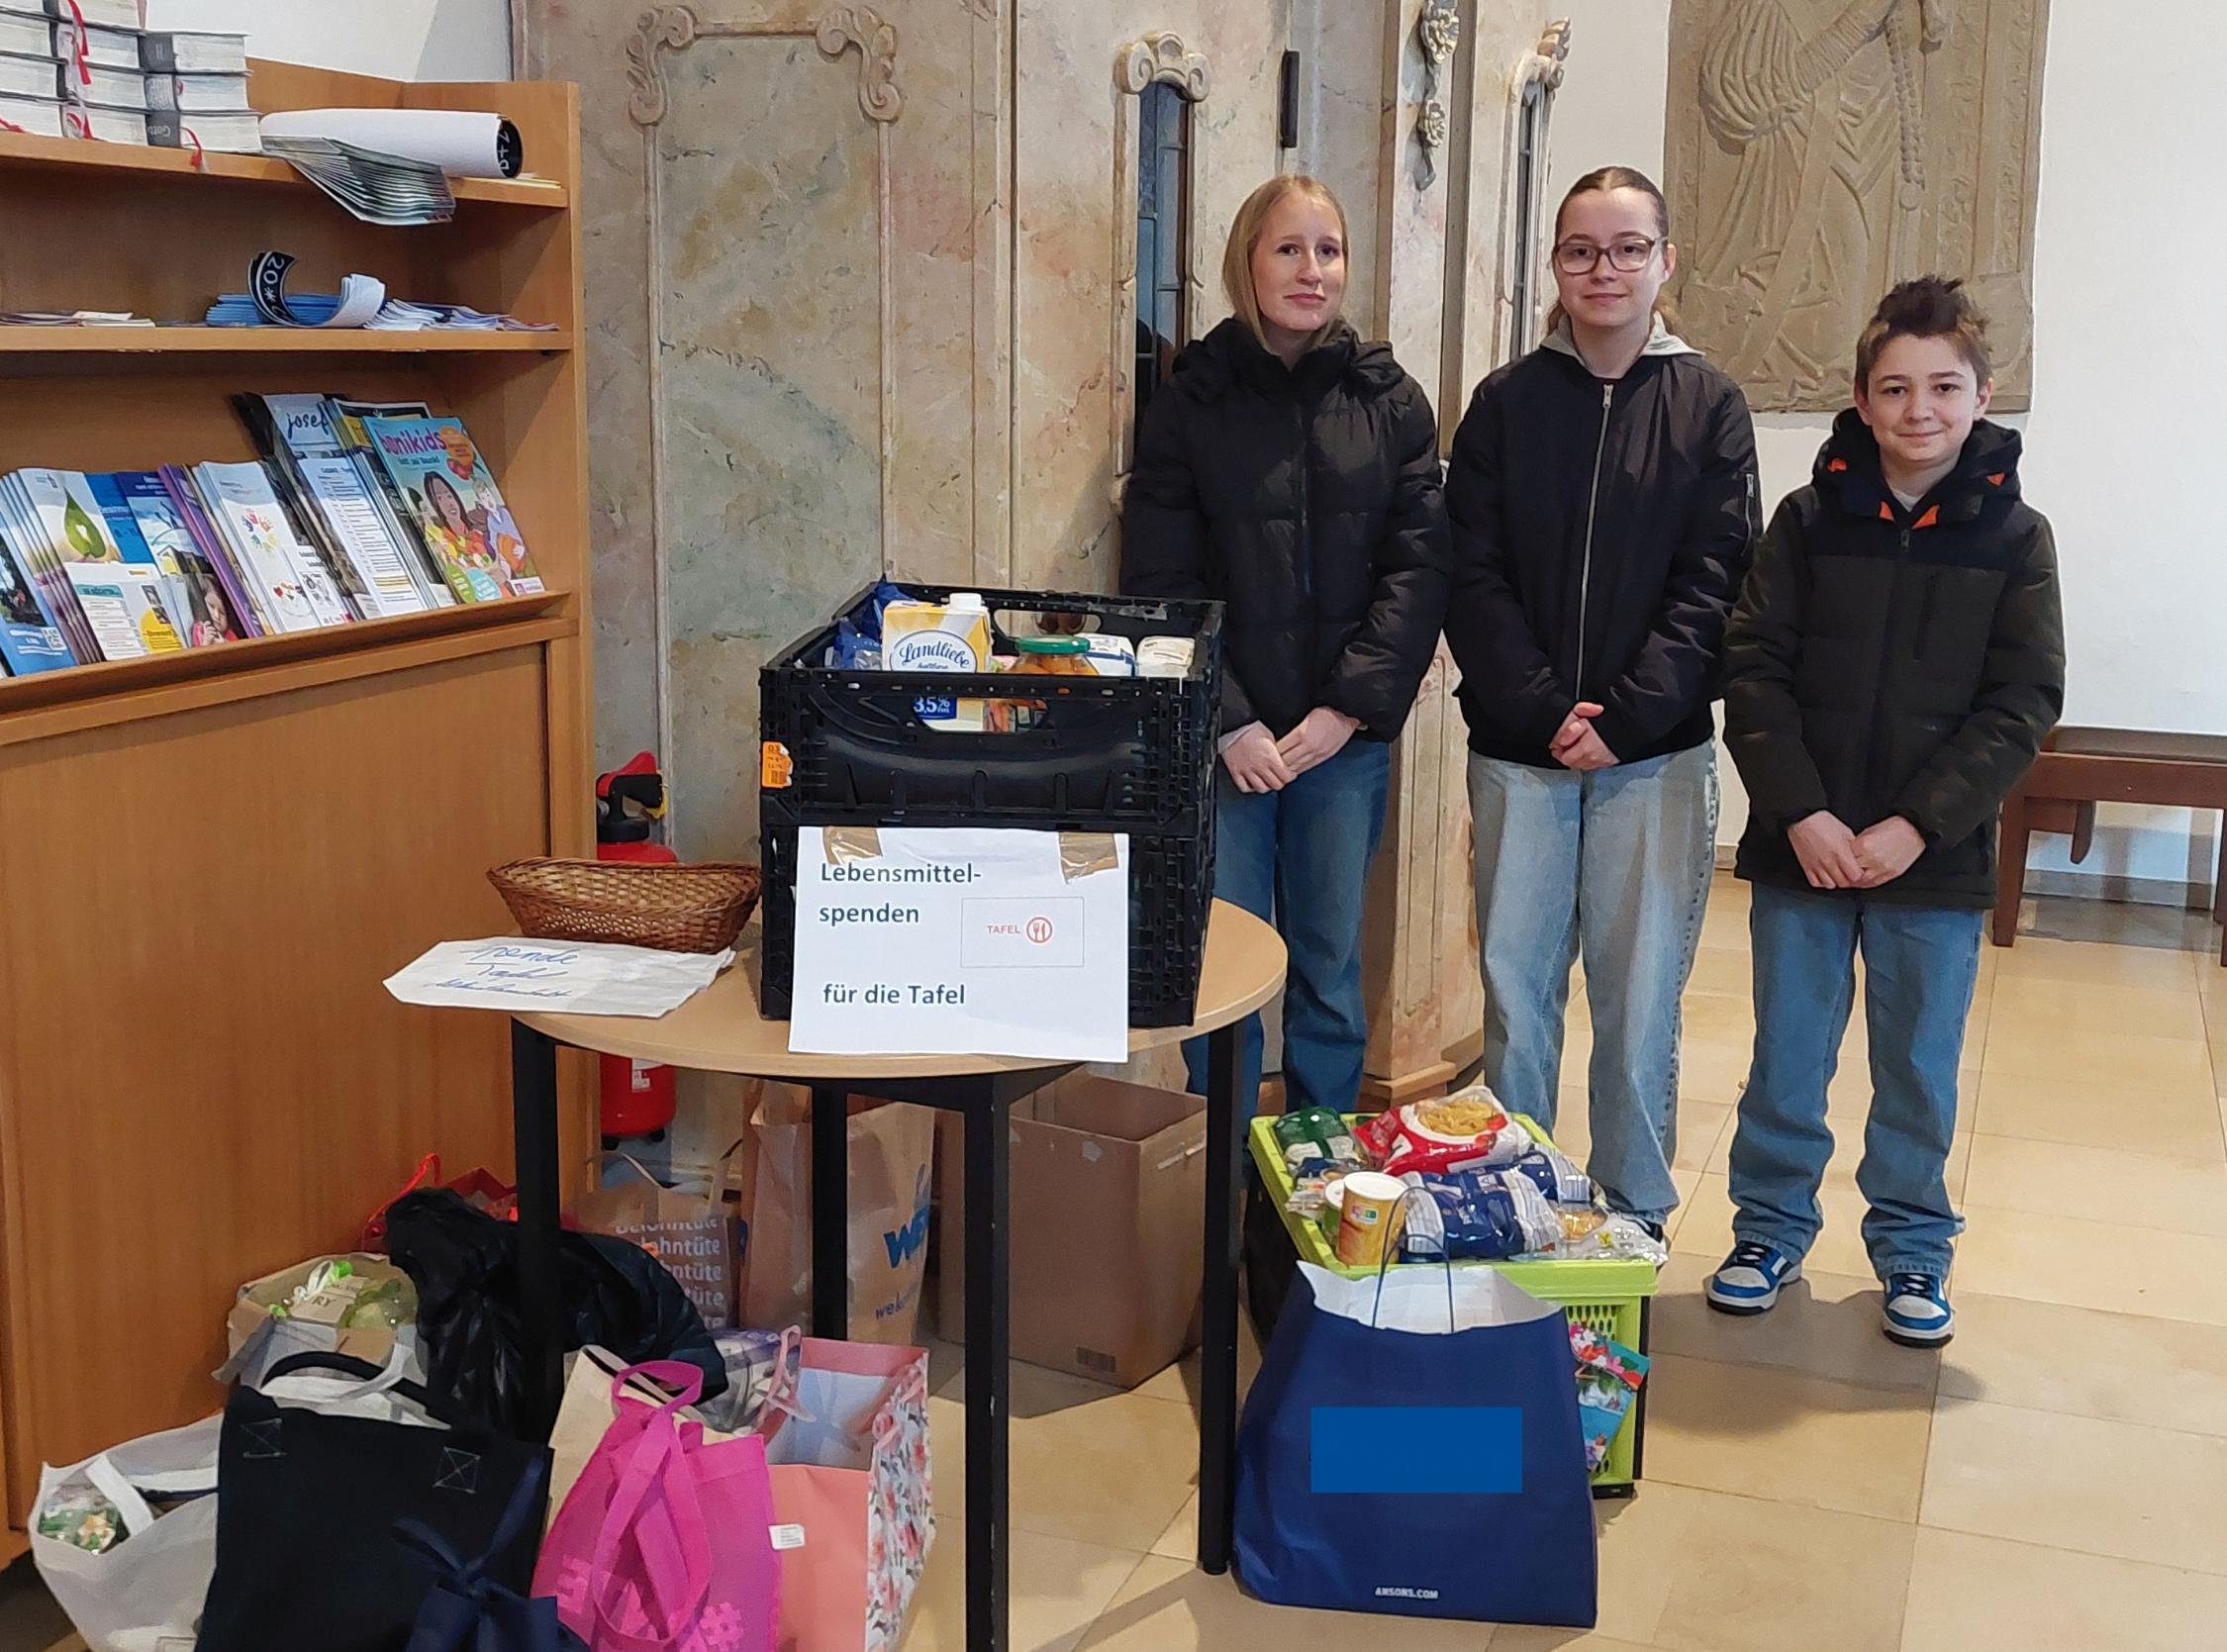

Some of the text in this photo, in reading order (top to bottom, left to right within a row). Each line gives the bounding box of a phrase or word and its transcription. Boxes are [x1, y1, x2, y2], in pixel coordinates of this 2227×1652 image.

[374, 426, 447, 455] bonikids
[899, 640, 970, 669] Landliebe
[821, 862, 982, 883] Lebensmittel-
[819, 903, 920, 926] spenden
[987, 923, 1022, 934] TAFEL
[823, 983, 966, 1005] für die Tafel
[1375, 1586, 1439, 1600] ANSONS.COM
